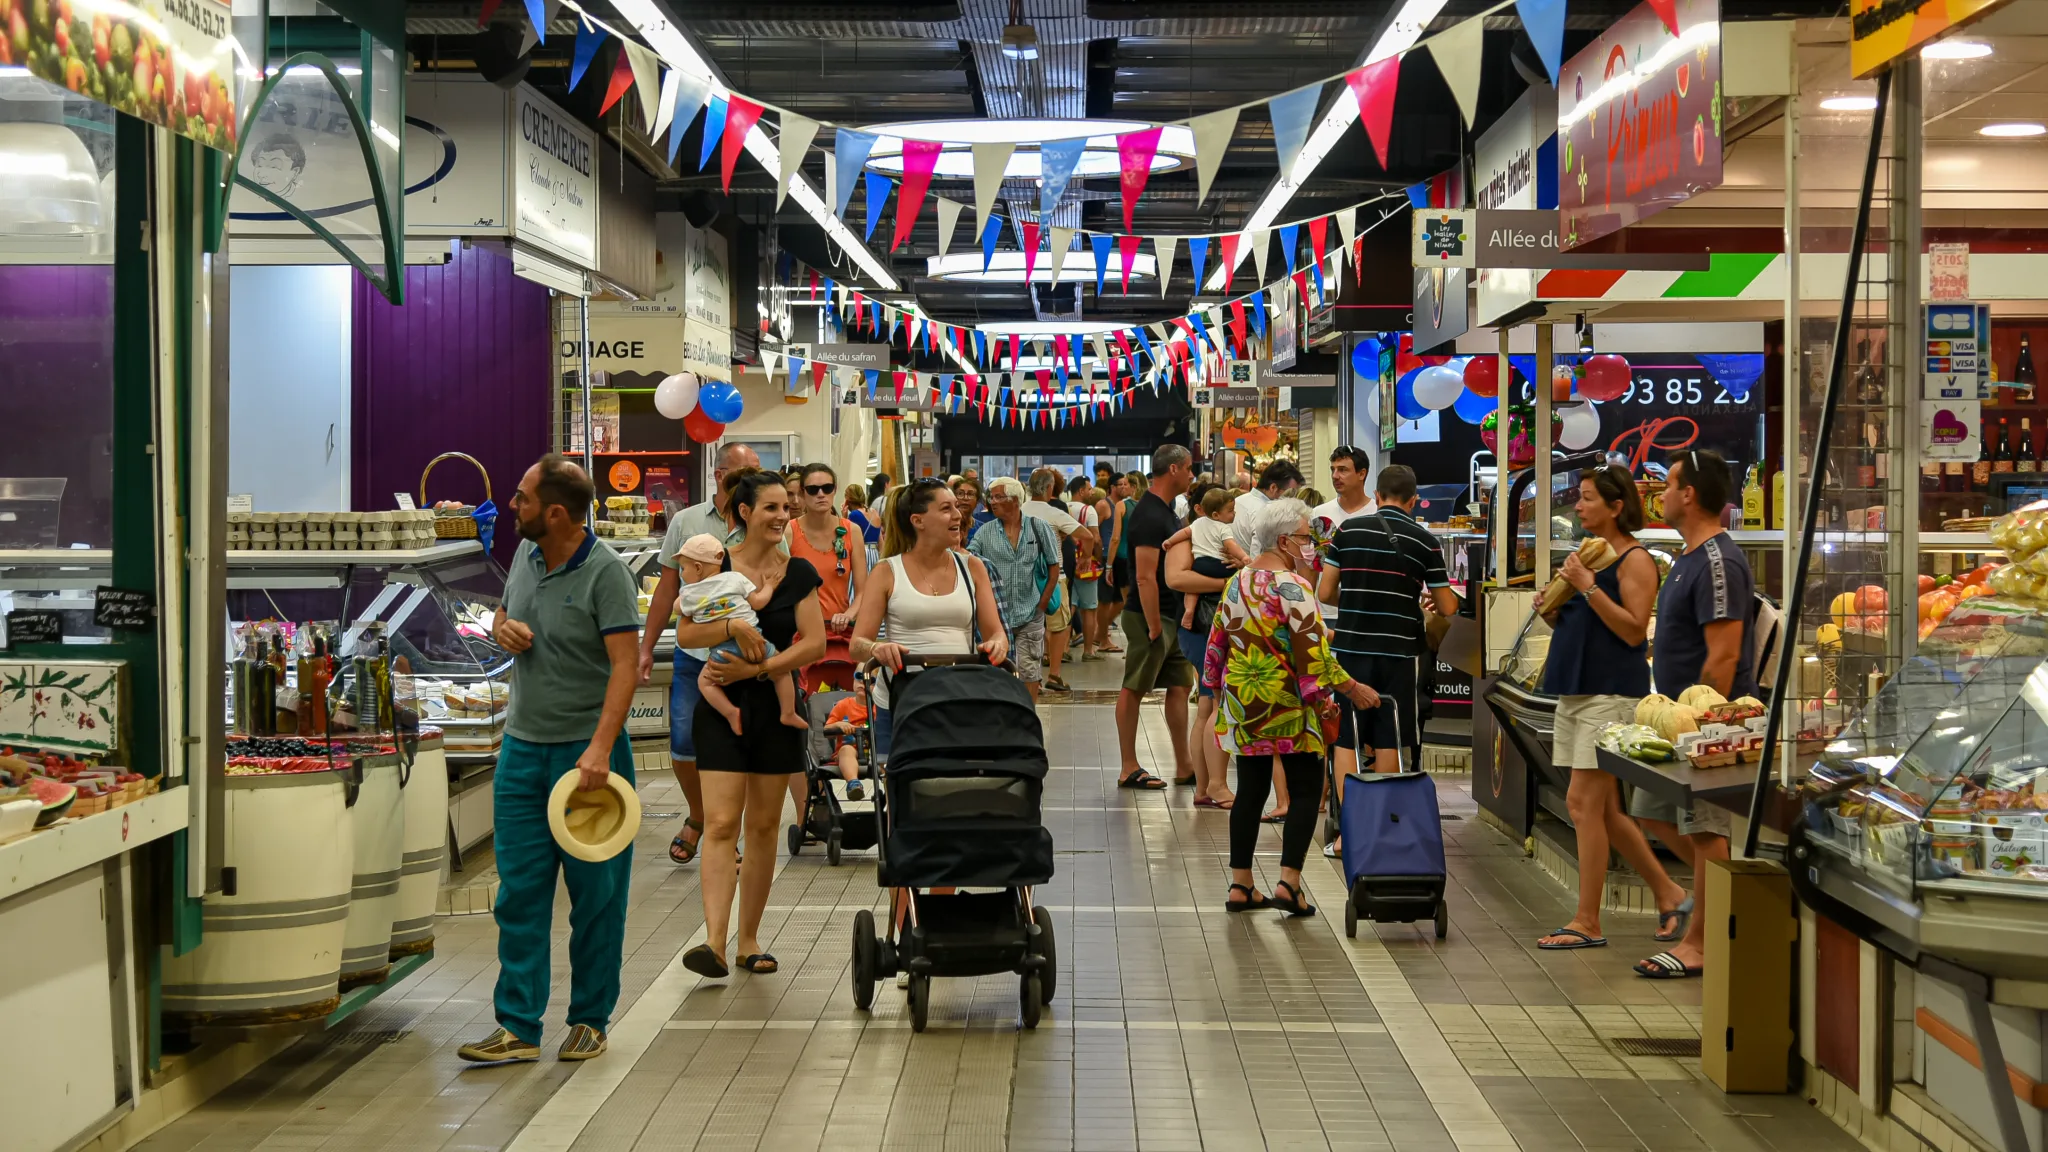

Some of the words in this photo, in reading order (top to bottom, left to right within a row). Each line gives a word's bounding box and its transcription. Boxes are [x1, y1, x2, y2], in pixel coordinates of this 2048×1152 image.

[522, 101, 590, 178] CREMERIE
[1489, 229, 1536, 248] Allée
[1955, 343, 1975, 351] VISA
[816, 352, 837, 361] Allée
[838, 352, 849, 361] du
[851, 352, 876, 361] safran
[1955, 360, 1975, 368] VISA
[1665, 378, 1702, 405] 85
[864, 392, 881, 402] Aée
[882, 392, 892, 402] du
[1218, 393, 1234, 401] Allée
[1235, 393, 1244, 401] du
